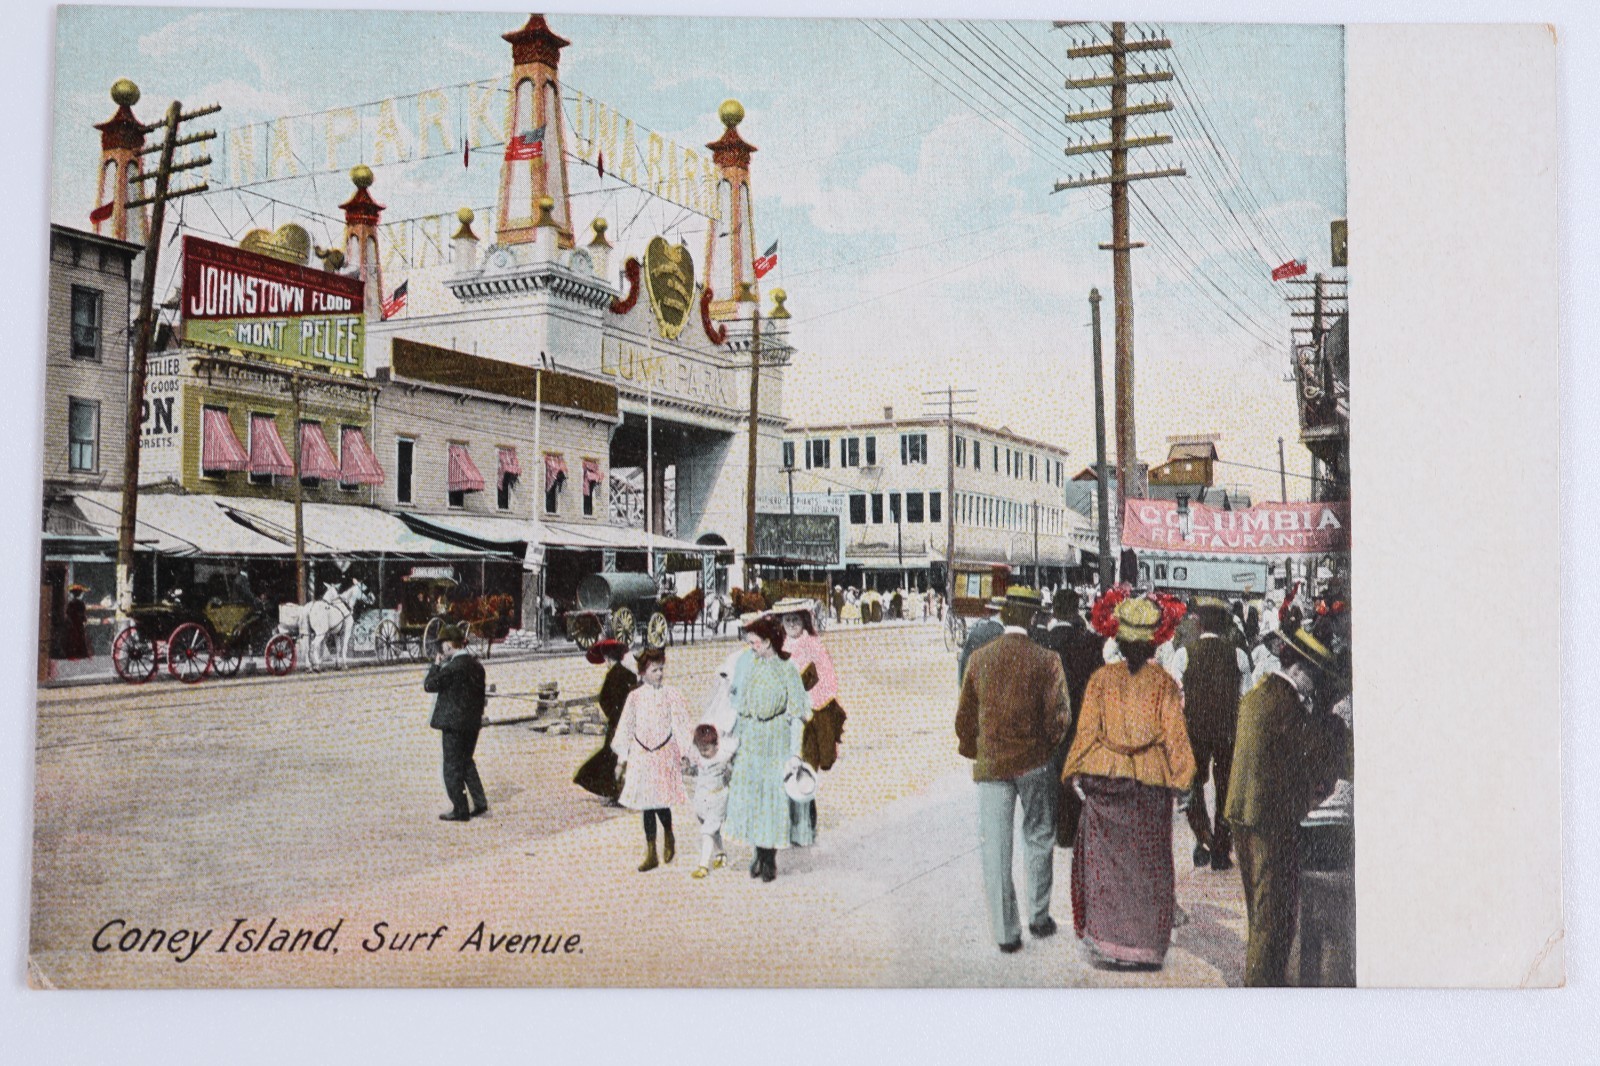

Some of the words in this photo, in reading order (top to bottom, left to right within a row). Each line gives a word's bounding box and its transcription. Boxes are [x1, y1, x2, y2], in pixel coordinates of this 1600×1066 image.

[325, 79, 509, 173] PARK
[190, 264, 304, 316] JOHNSTOWN
[311, 290, 352, 312] FLOOD
[237, 320, 288, 351] MONT
[300, 317, 362, 365] PELEE
[145, 358, 180, 377] OTTLIEB
[151, 379, 180, 394] GOODS
[1139, 506, 1341, 532] COLUMBIA
[92, 918, 213, 962] Coney
[362, 921, 448, 953] Surf
[459, 921, 584, 954] Avenue.
